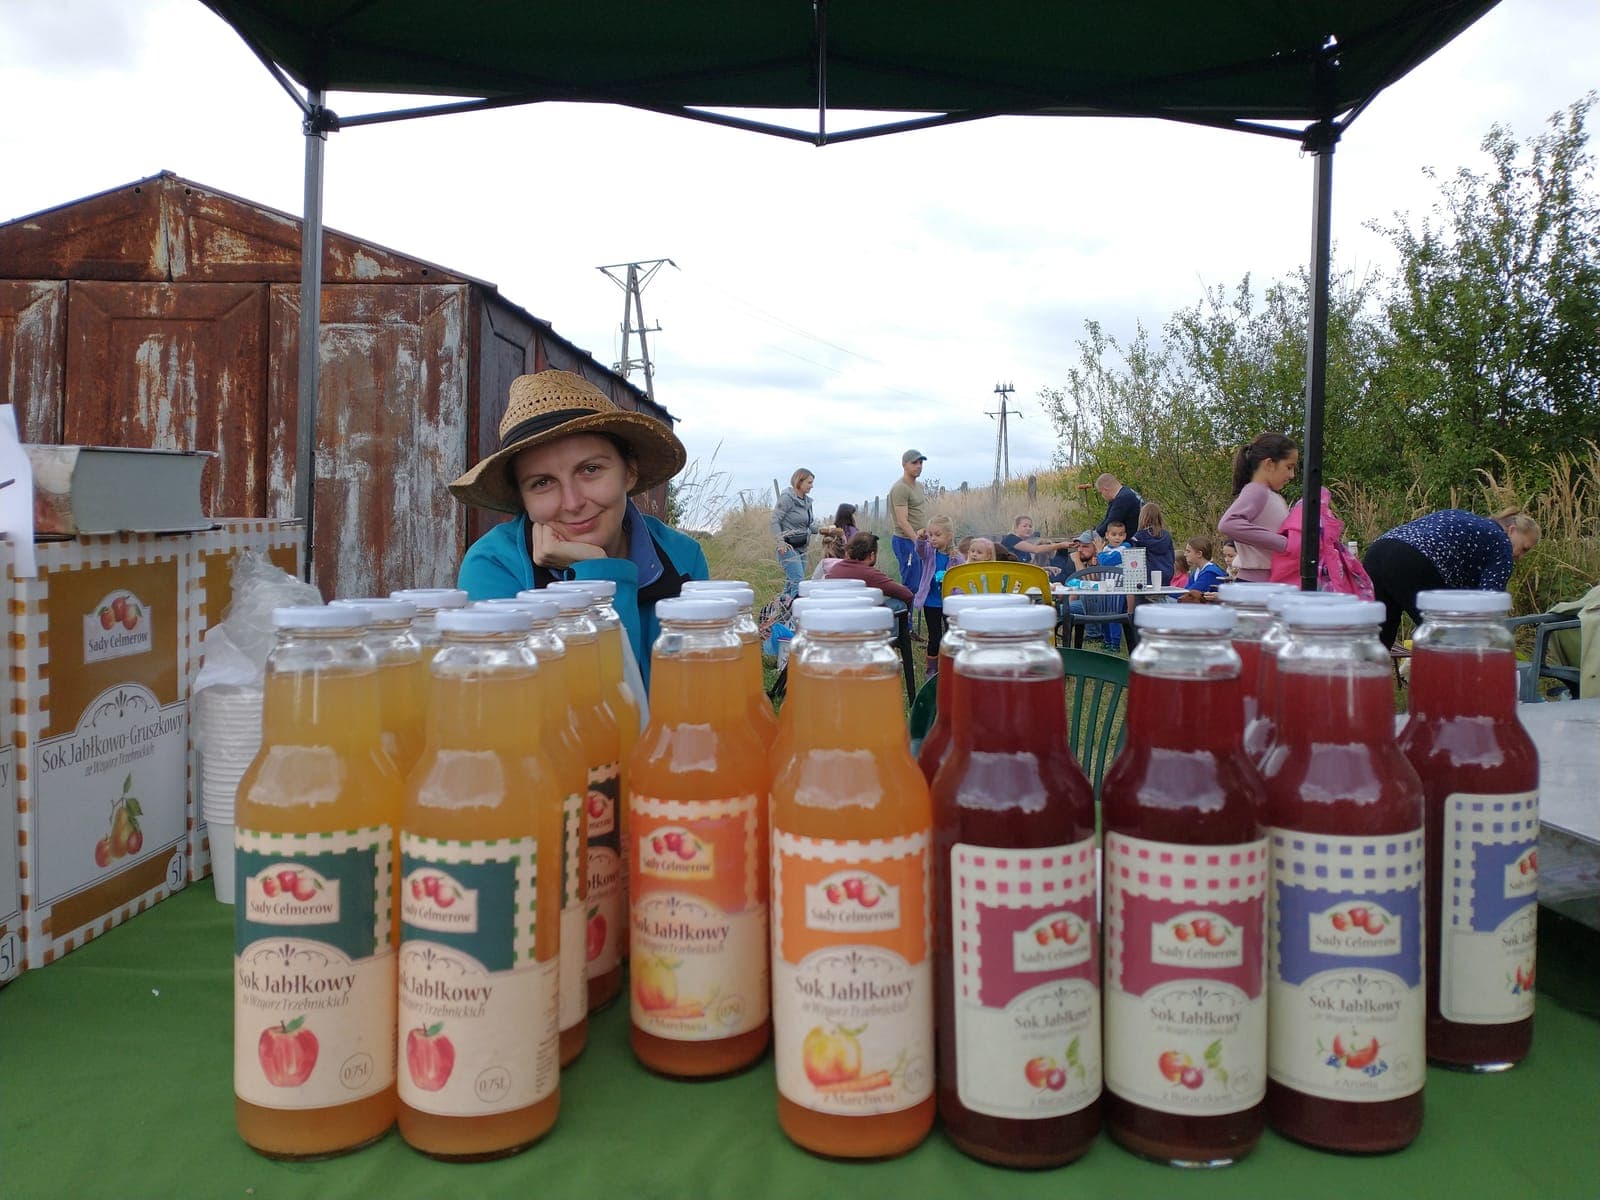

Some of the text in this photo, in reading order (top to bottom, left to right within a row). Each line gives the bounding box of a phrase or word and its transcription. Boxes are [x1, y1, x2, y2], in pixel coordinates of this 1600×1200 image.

[88, 633, 109, 653] Sady
[42, 749, 69, 774] Sok
[68, 713, 184, 765] Jabłkowo-Gruszkowy
[249, 901, 273, 916] Sady
[811, 907, 836, 923] Sady
[1314, 934, 1342, 949] Sady
[239, 968, 357, 1000] Sok Jabłkowy
[795, 976, 825, 999] Sok
[1310, 995, 1336, 1011] Sok
[1015, 1015, 1040, 1030] Sok
[1150, 1006, 1177, 1024] Sok
